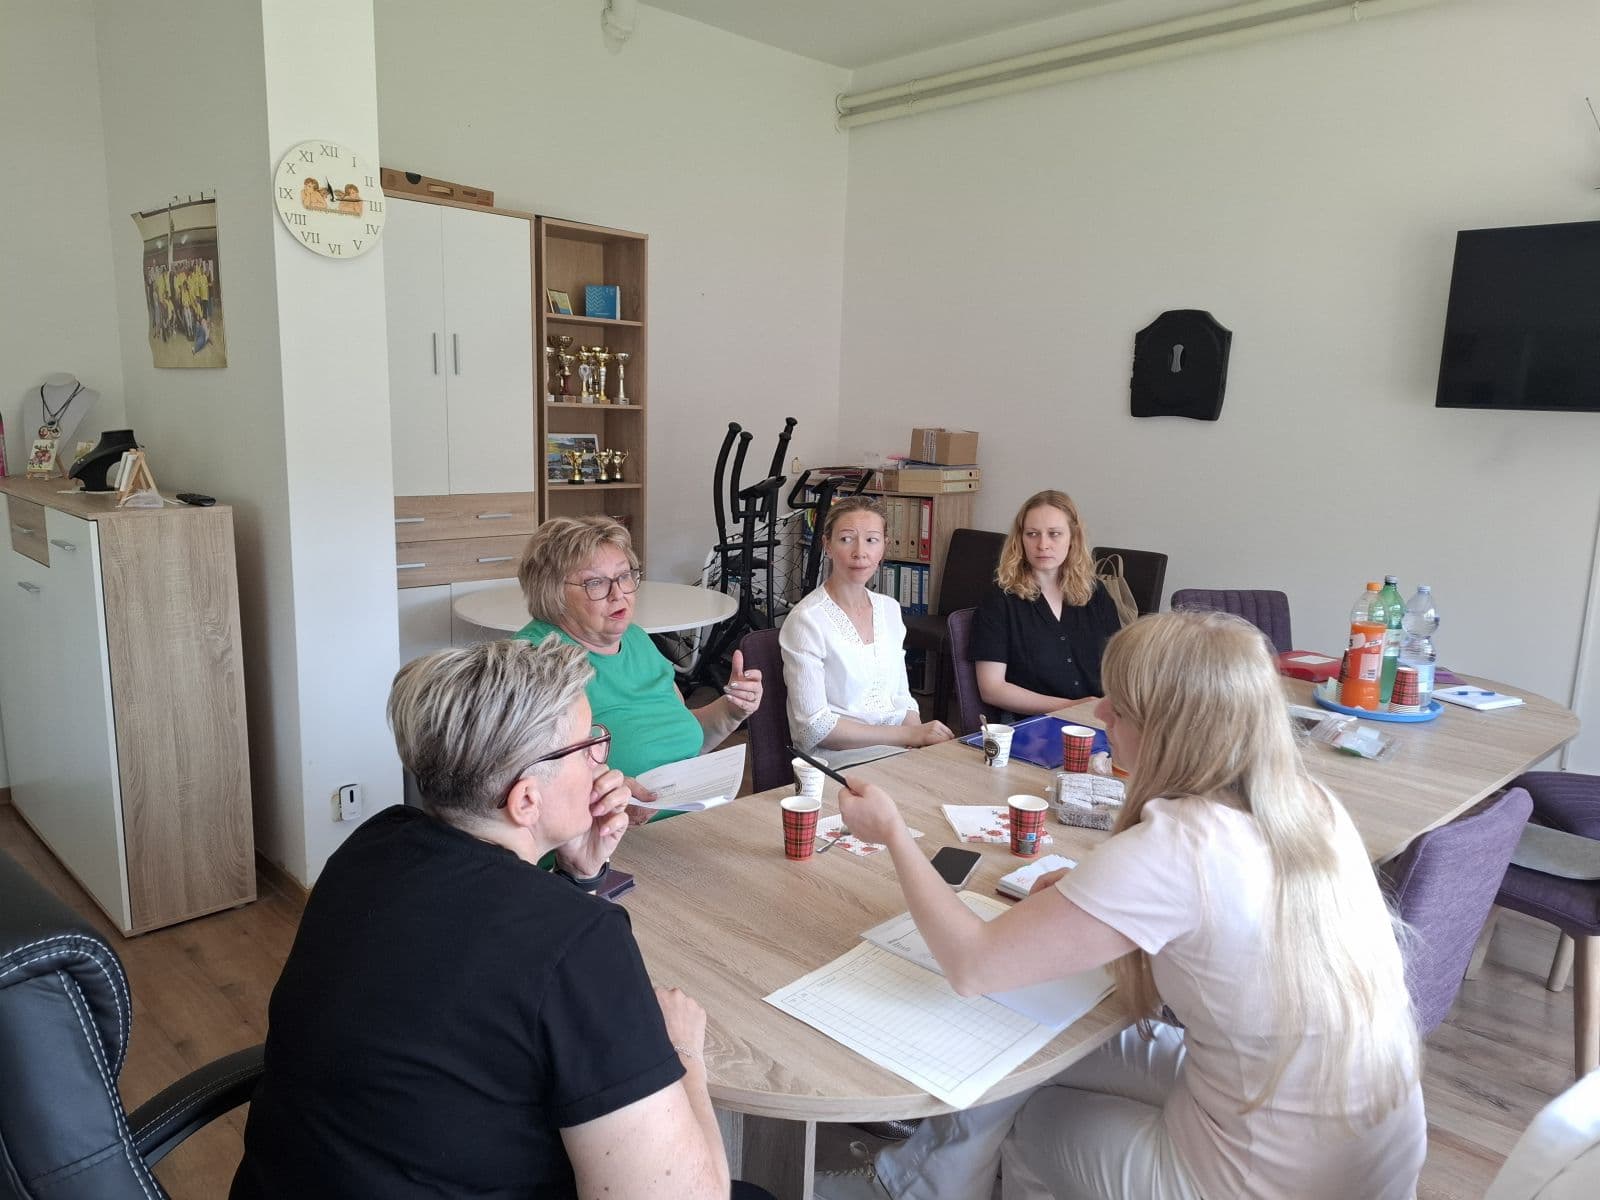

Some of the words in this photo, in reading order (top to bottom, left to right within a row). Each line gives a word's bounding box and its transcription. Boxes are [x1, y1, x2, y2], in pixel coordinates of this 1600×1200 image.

[299, 150, 314, 163] XI
[320, 144, 338, 158] XII
[351, 156, 357, 168] I
[286, 163, 296, 174] X
[364, 176, 374, 187] II
[279, 187, 293, 200] IX
[369, 201, 382, 212] III
[285, 212, 307, 226] VIII
[366, 224, 380, 235] IV
[301, 231, 320, 244] VII
[328, 243, 341, 255] VI
[353, 240, 362, 250] V
